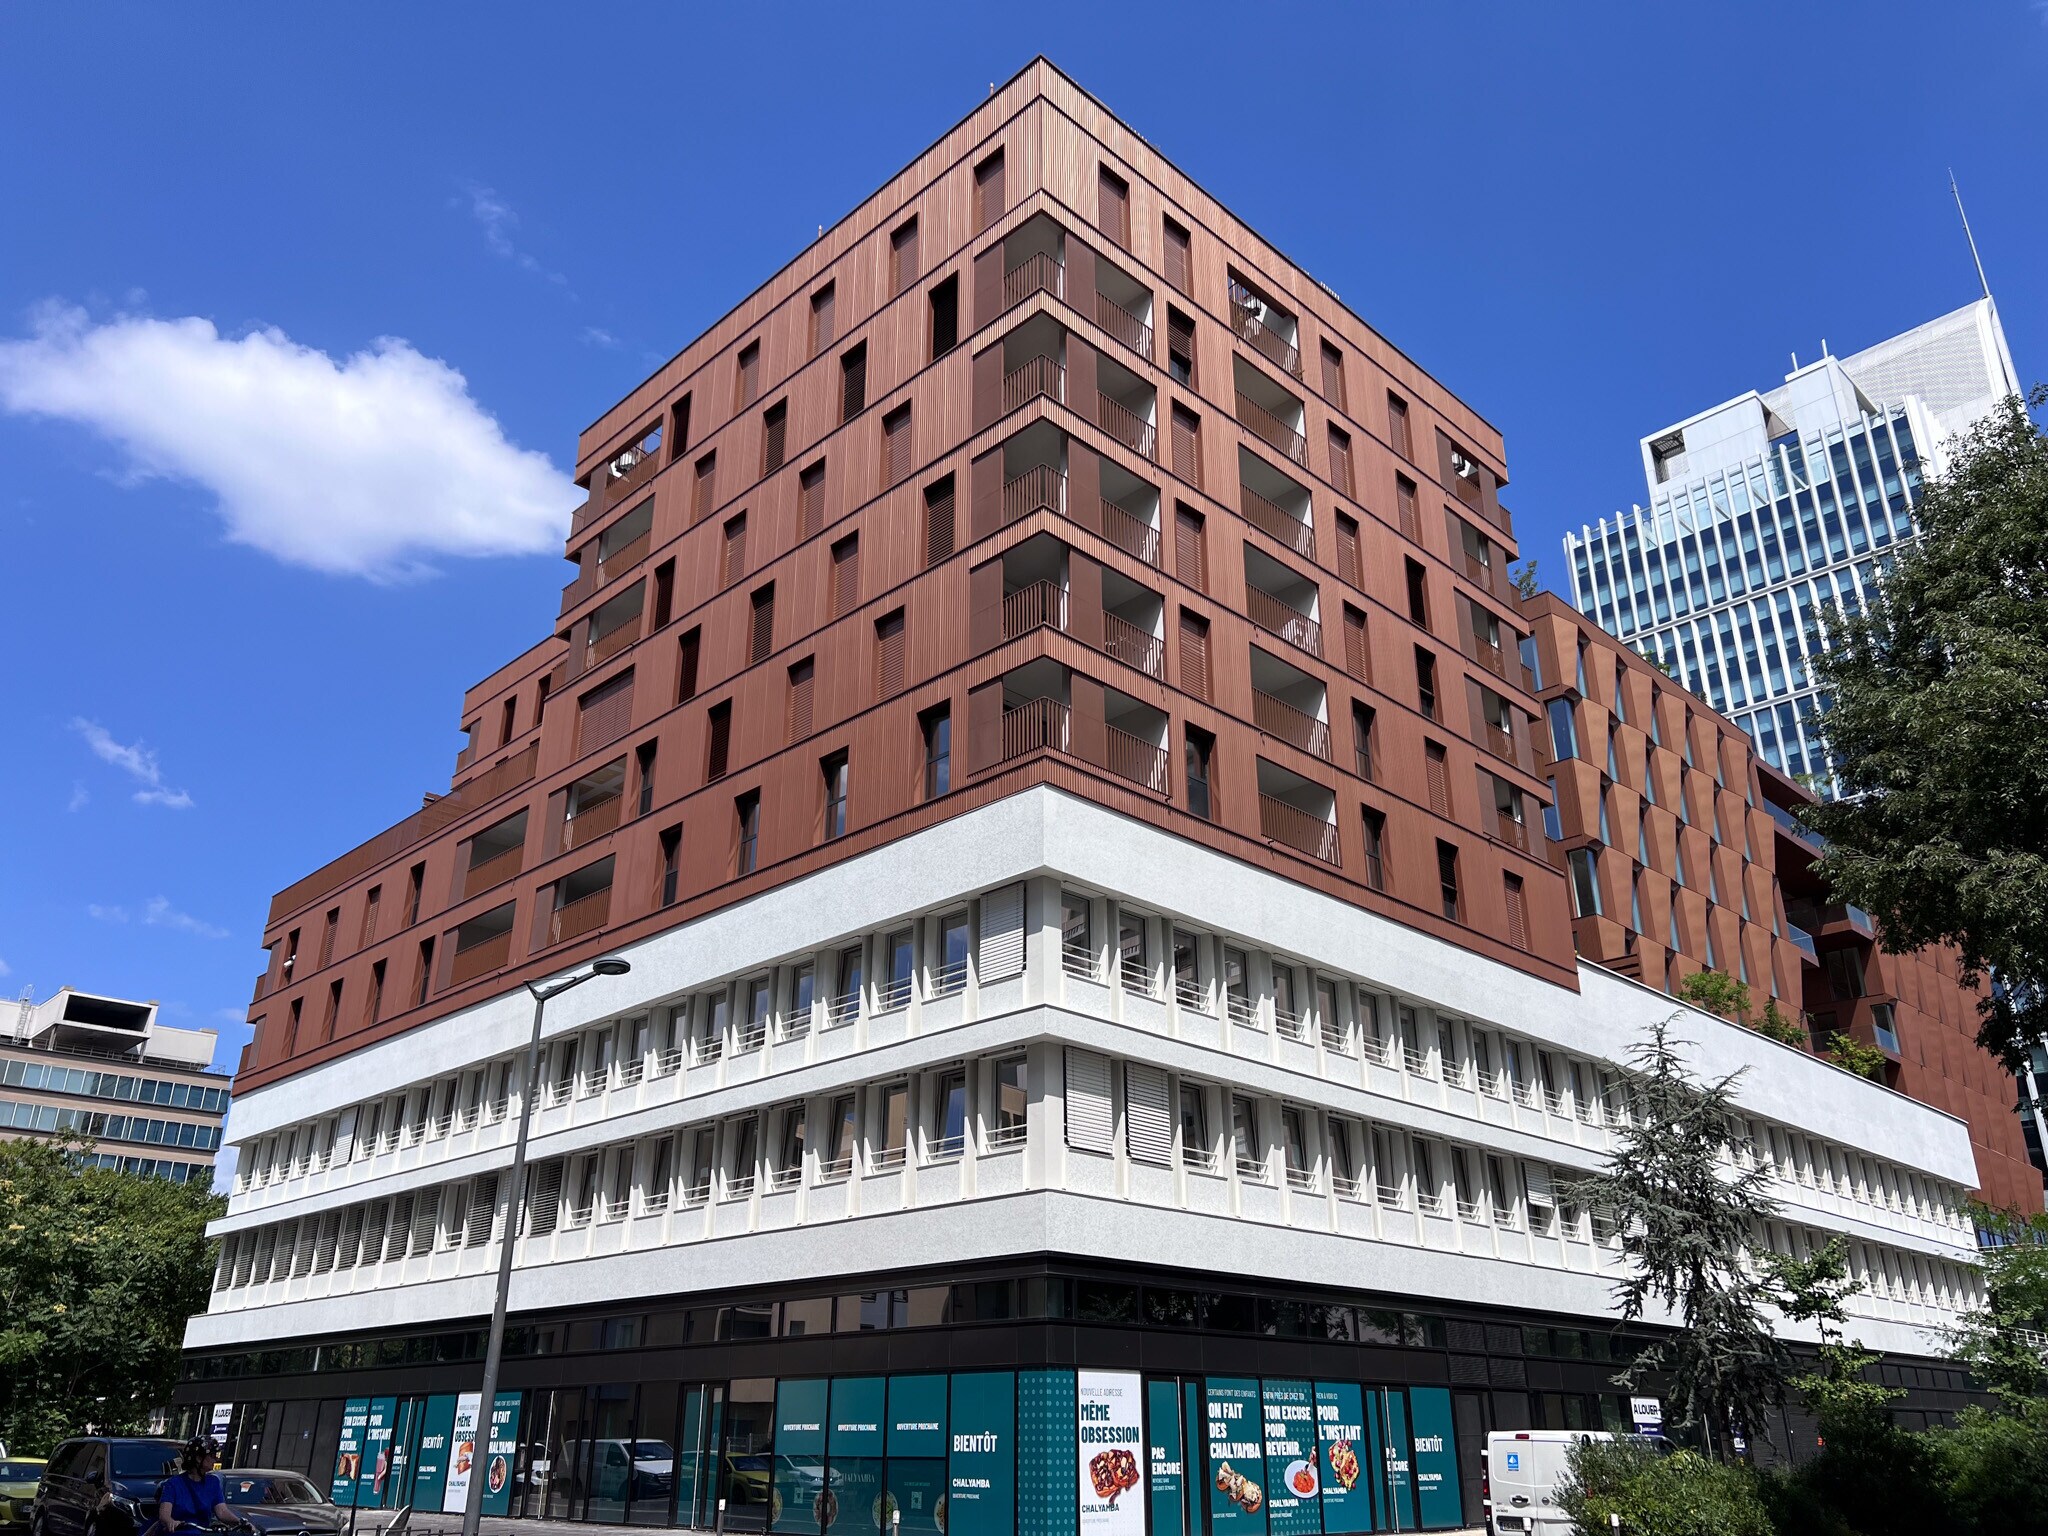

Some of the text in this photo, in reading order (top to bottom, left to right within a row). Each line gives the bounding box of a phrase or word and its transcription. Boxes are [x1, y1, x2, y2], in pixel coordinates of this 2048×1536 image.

[1081, 1388, 1123, 1396] NOUVELLE ADRESSE
[1081, 1400, 1110, 1421] MÊME
[1208, 1402, 1243, 1419] ON FAIT
[1264, 1406, 1311, 1420] TON EXCUSE
[1317, 1405, 1339, 1421] POUR
[1634, 1404, 1658, 1415] A LOUER
[370, 1415, 382, 1426] POUR
[457, 1413, 471, 1427] MÊME
[498, 1411, 511, 1423] FAIT
[367, 1428, 392, 1440] L'INSTANT
[490, 1426, 498, 1439] ES
[1081, 1426, 1139, 1443] OBSESSION
[1209, 1423, 1227, 1439] DES
[1265, 1423, 1286, 1438] POUR
[1319, 1425, 1361, 1440] L'INSTANT
[422, 1434, 444, 1448] BIENTÔT
[488, 1441, 516, 1453] HALYAMBA
[953, 1431, 997, 1452] BIENTÔT
[1415, 1434, 1443, 1452] BIENTÔT
[1152, 1447, 1165, 1460] PAS
[1210, 1443, 1261, 1459] CHALYAMBA
[1266, 1441, 1302, 1456] REVENIR.
[1152, 1462, 1181, 1475] ENCORE
[953, 1479, 990, 1488] CHALYAMBA
[1082, 1504, 1119, 1513] CHALYAMBA
[1269, 1499, 1299, 1507] CHALYAMBA
